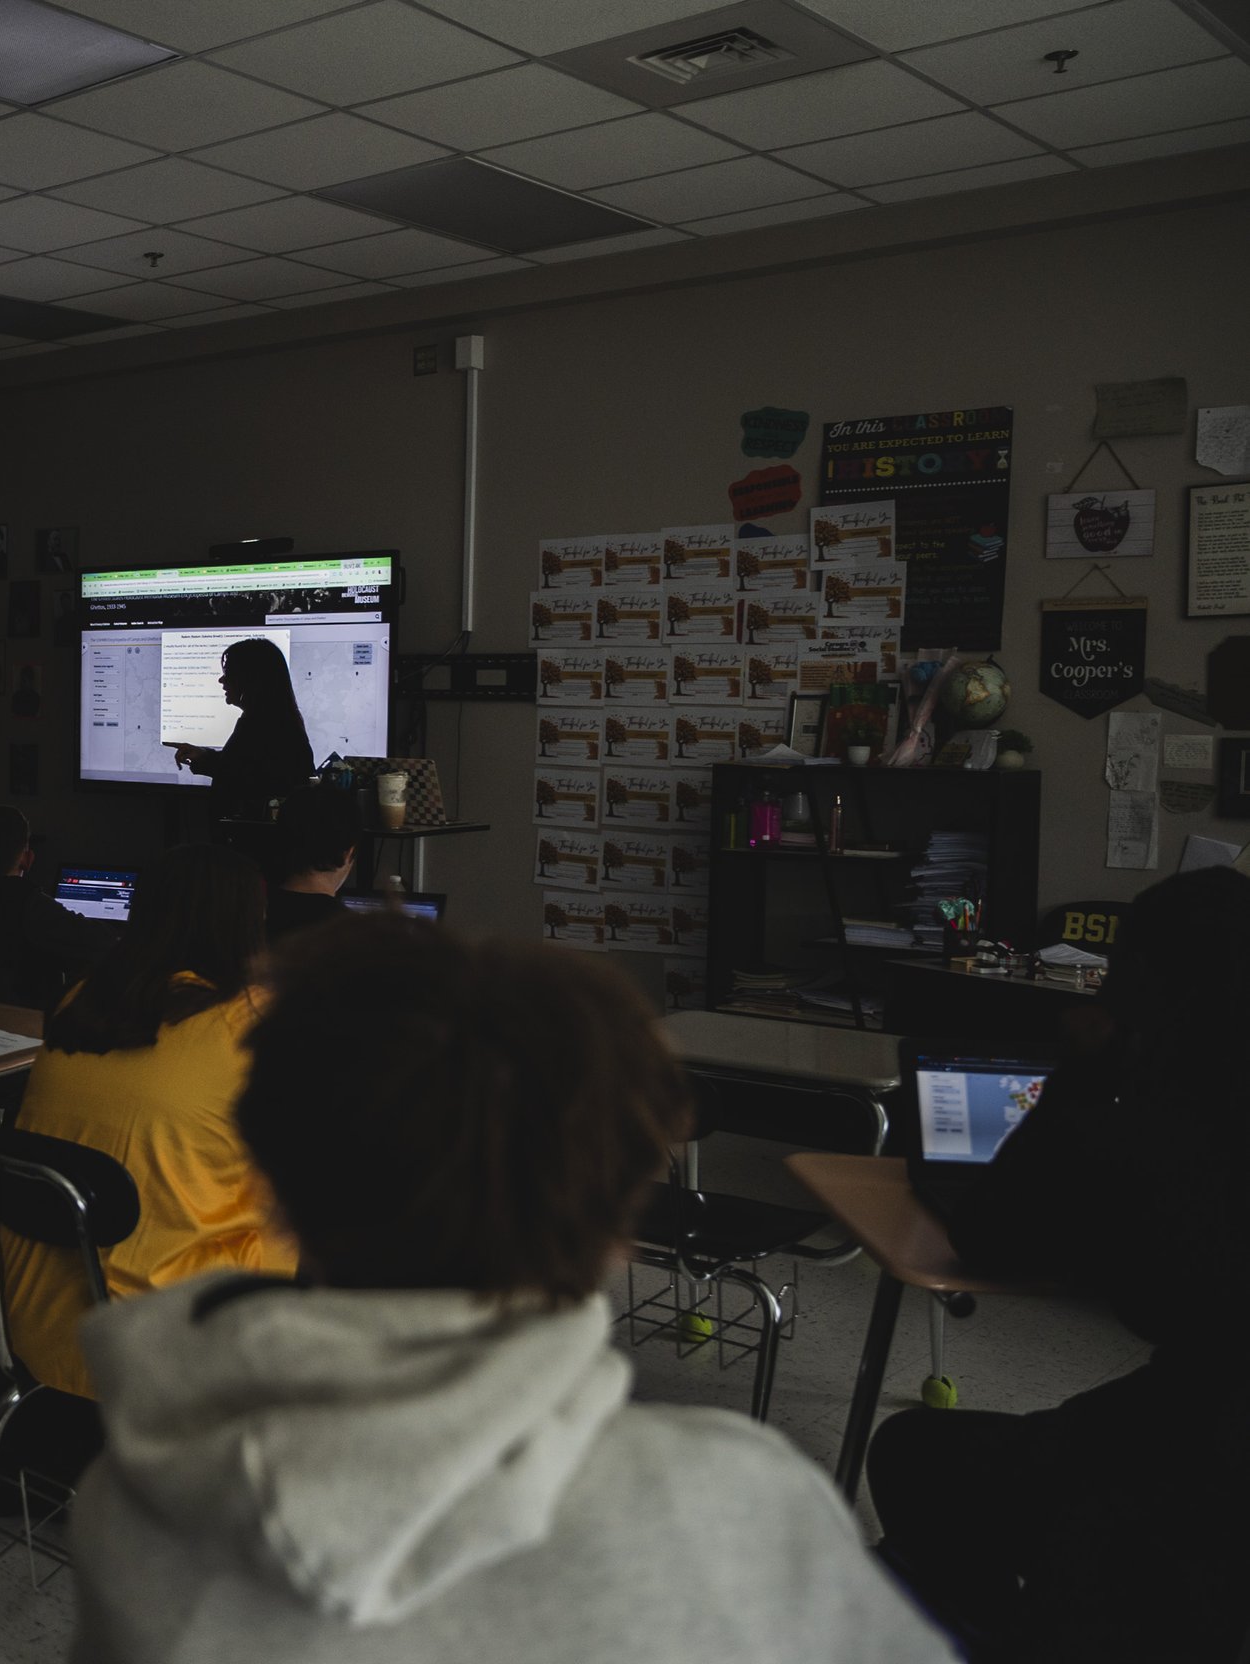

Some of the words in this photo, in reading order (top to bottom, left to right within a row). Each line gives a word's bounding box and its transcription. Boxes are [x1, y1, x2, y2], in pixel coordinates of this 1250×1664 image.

[830, 421, 851, 438] In
[855, 420, 886, 434] this
[827, 444, 849, 452] YOU
[852, 441, 875, 450] ARE
[879, 436, 943, 448] EXPECTED
[948, 434, 963, 443] TO
[968, 430, 1010, 441] LEARN
[838, 450, 991, 479] HISTORY
[354, 595, 380, 603] MUSEUM
[1065, 621, 1107, 632] WELCOME
[1068, 637, 1110, 661] Mrs.
[1051, 662, 1133, 687] Cooper's
